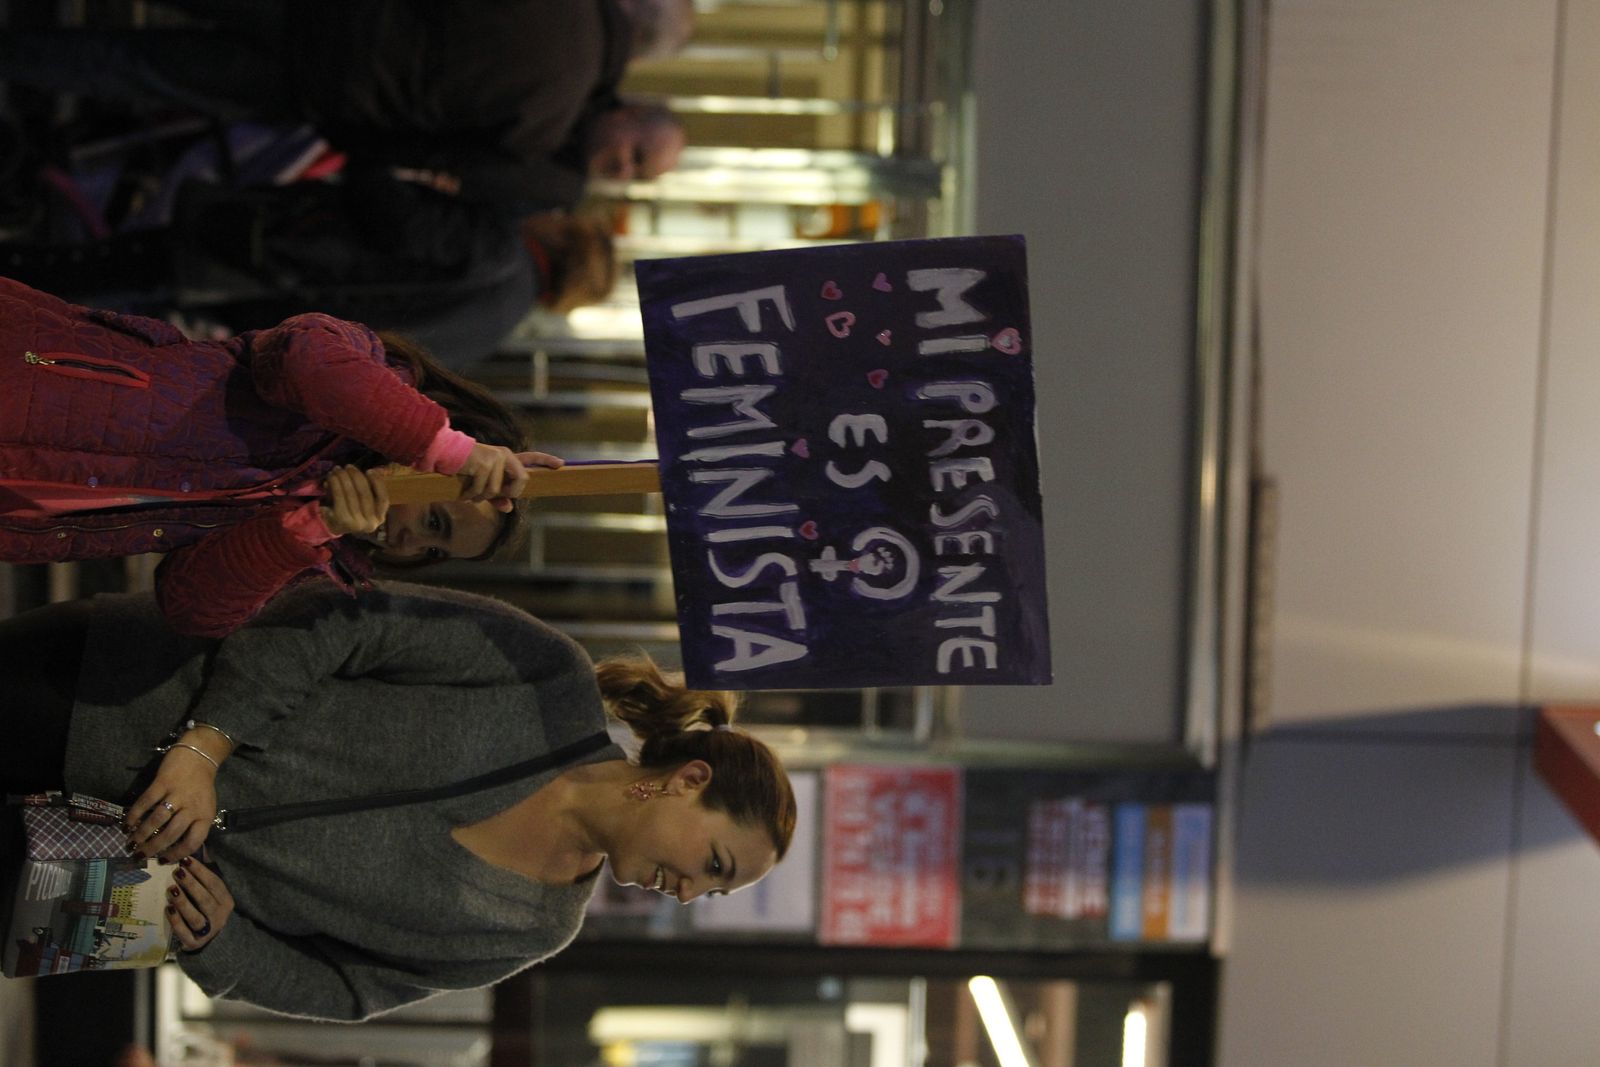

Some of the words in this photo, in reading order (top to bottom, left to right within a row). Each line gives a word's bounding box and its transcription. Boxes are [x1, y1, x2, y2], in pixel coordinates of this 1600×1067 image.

[671, 285, 818, 673] FEMINISTA
[825, 413, 892, 488] ES
[916, 380, 1003, 674] PRESENTE
